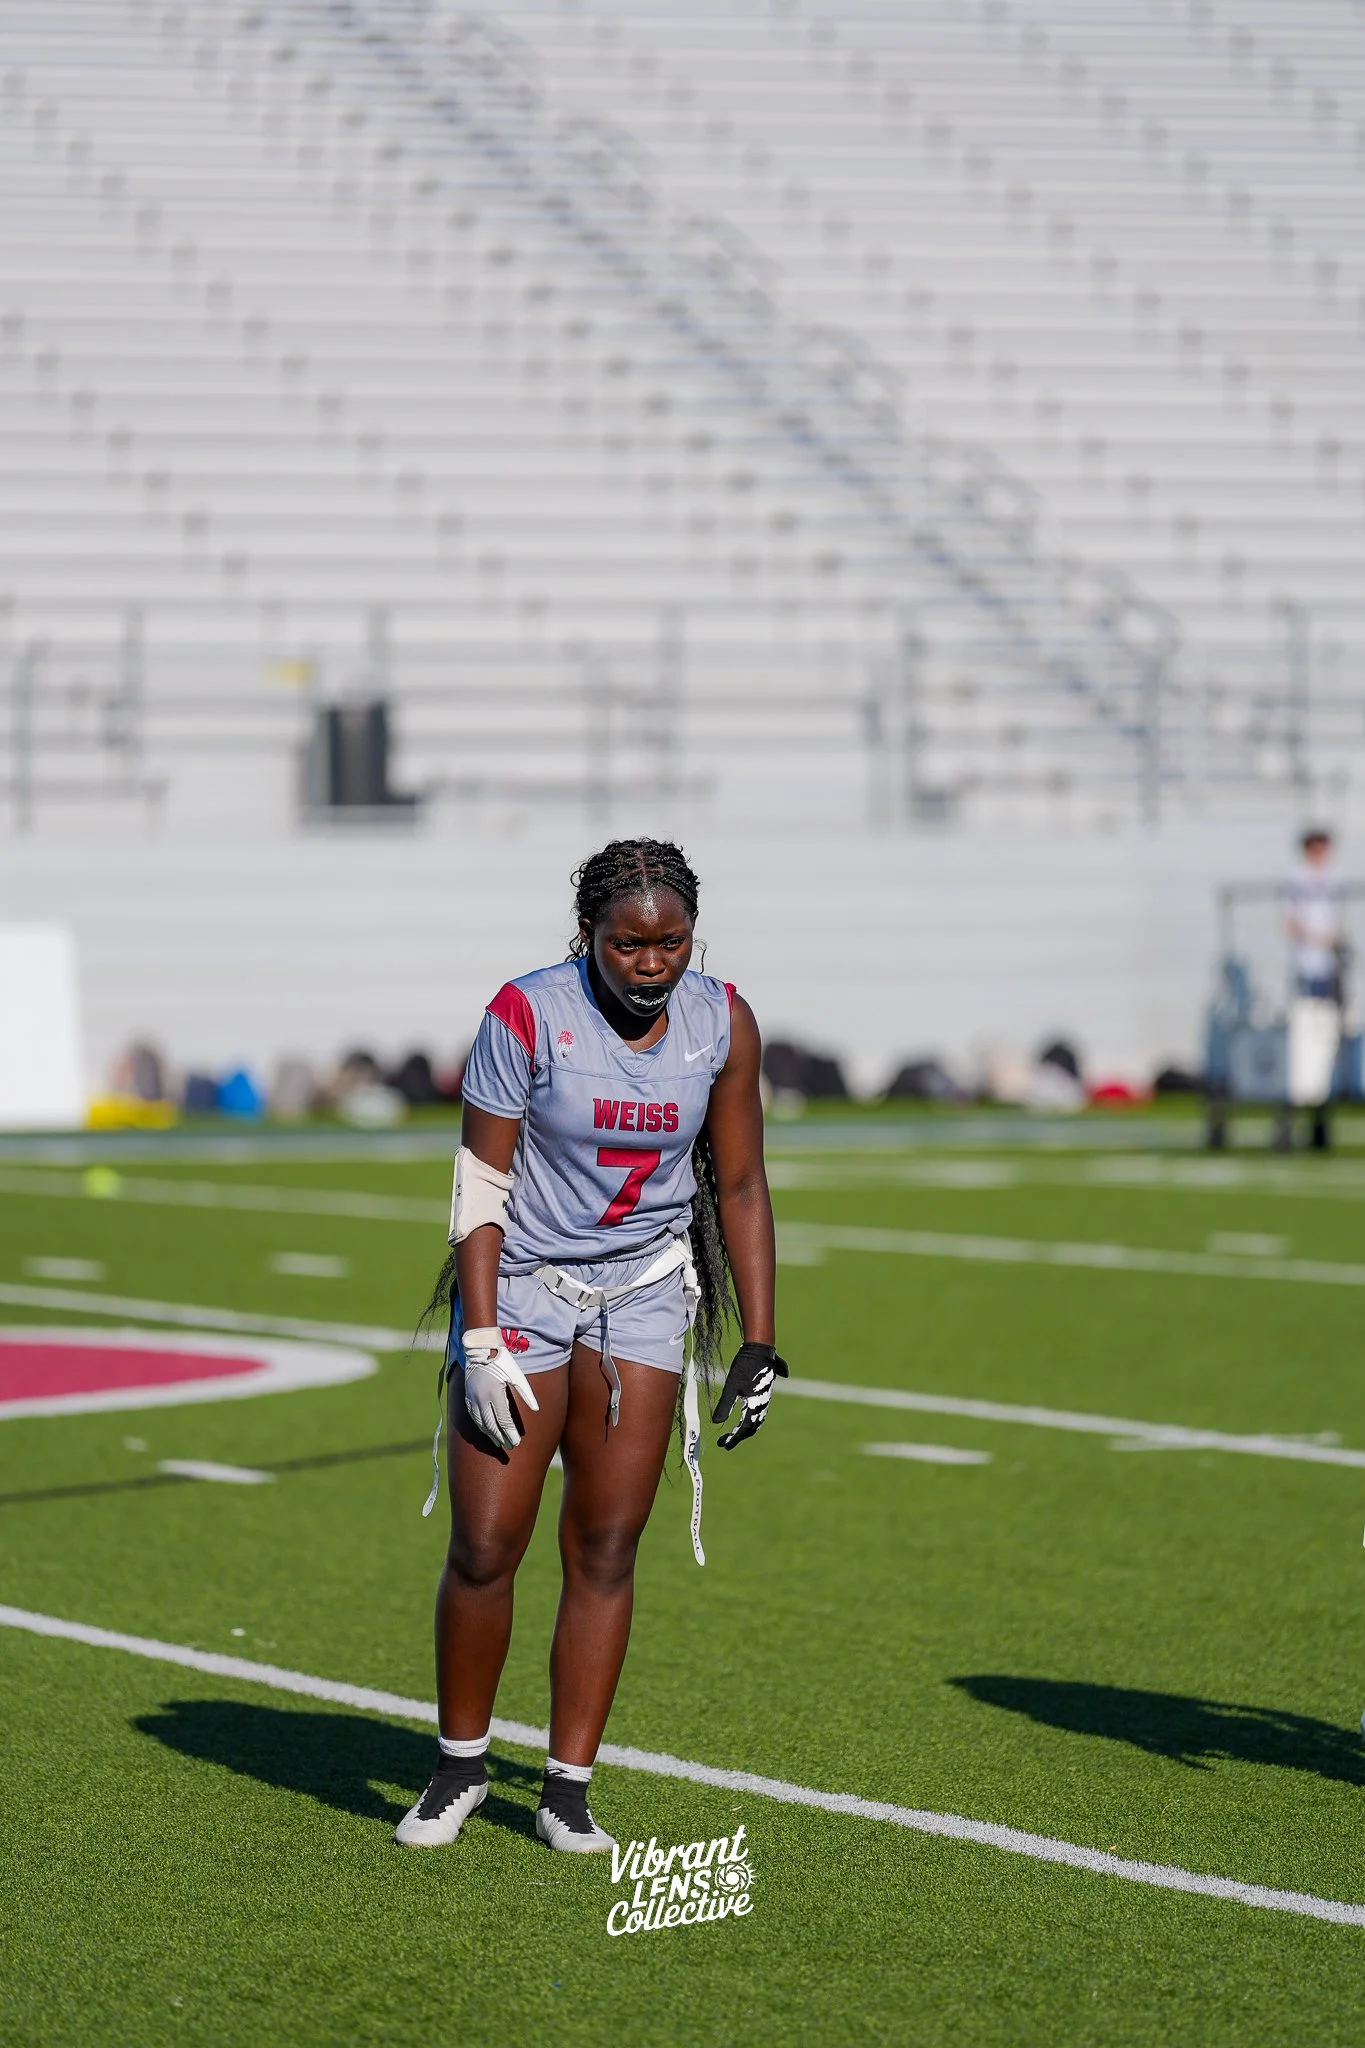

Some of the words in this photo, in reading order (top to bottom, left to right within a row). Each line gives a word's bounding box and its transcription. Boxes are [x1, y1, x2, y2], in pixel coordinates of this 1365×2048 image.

[593, 1097, 679, 1132] WEISS
[597, 1147, 662, 1226] 7
[688, 1443, 697, 1477] USA
[693, 1478, 701, 1555] FOOTBALL
